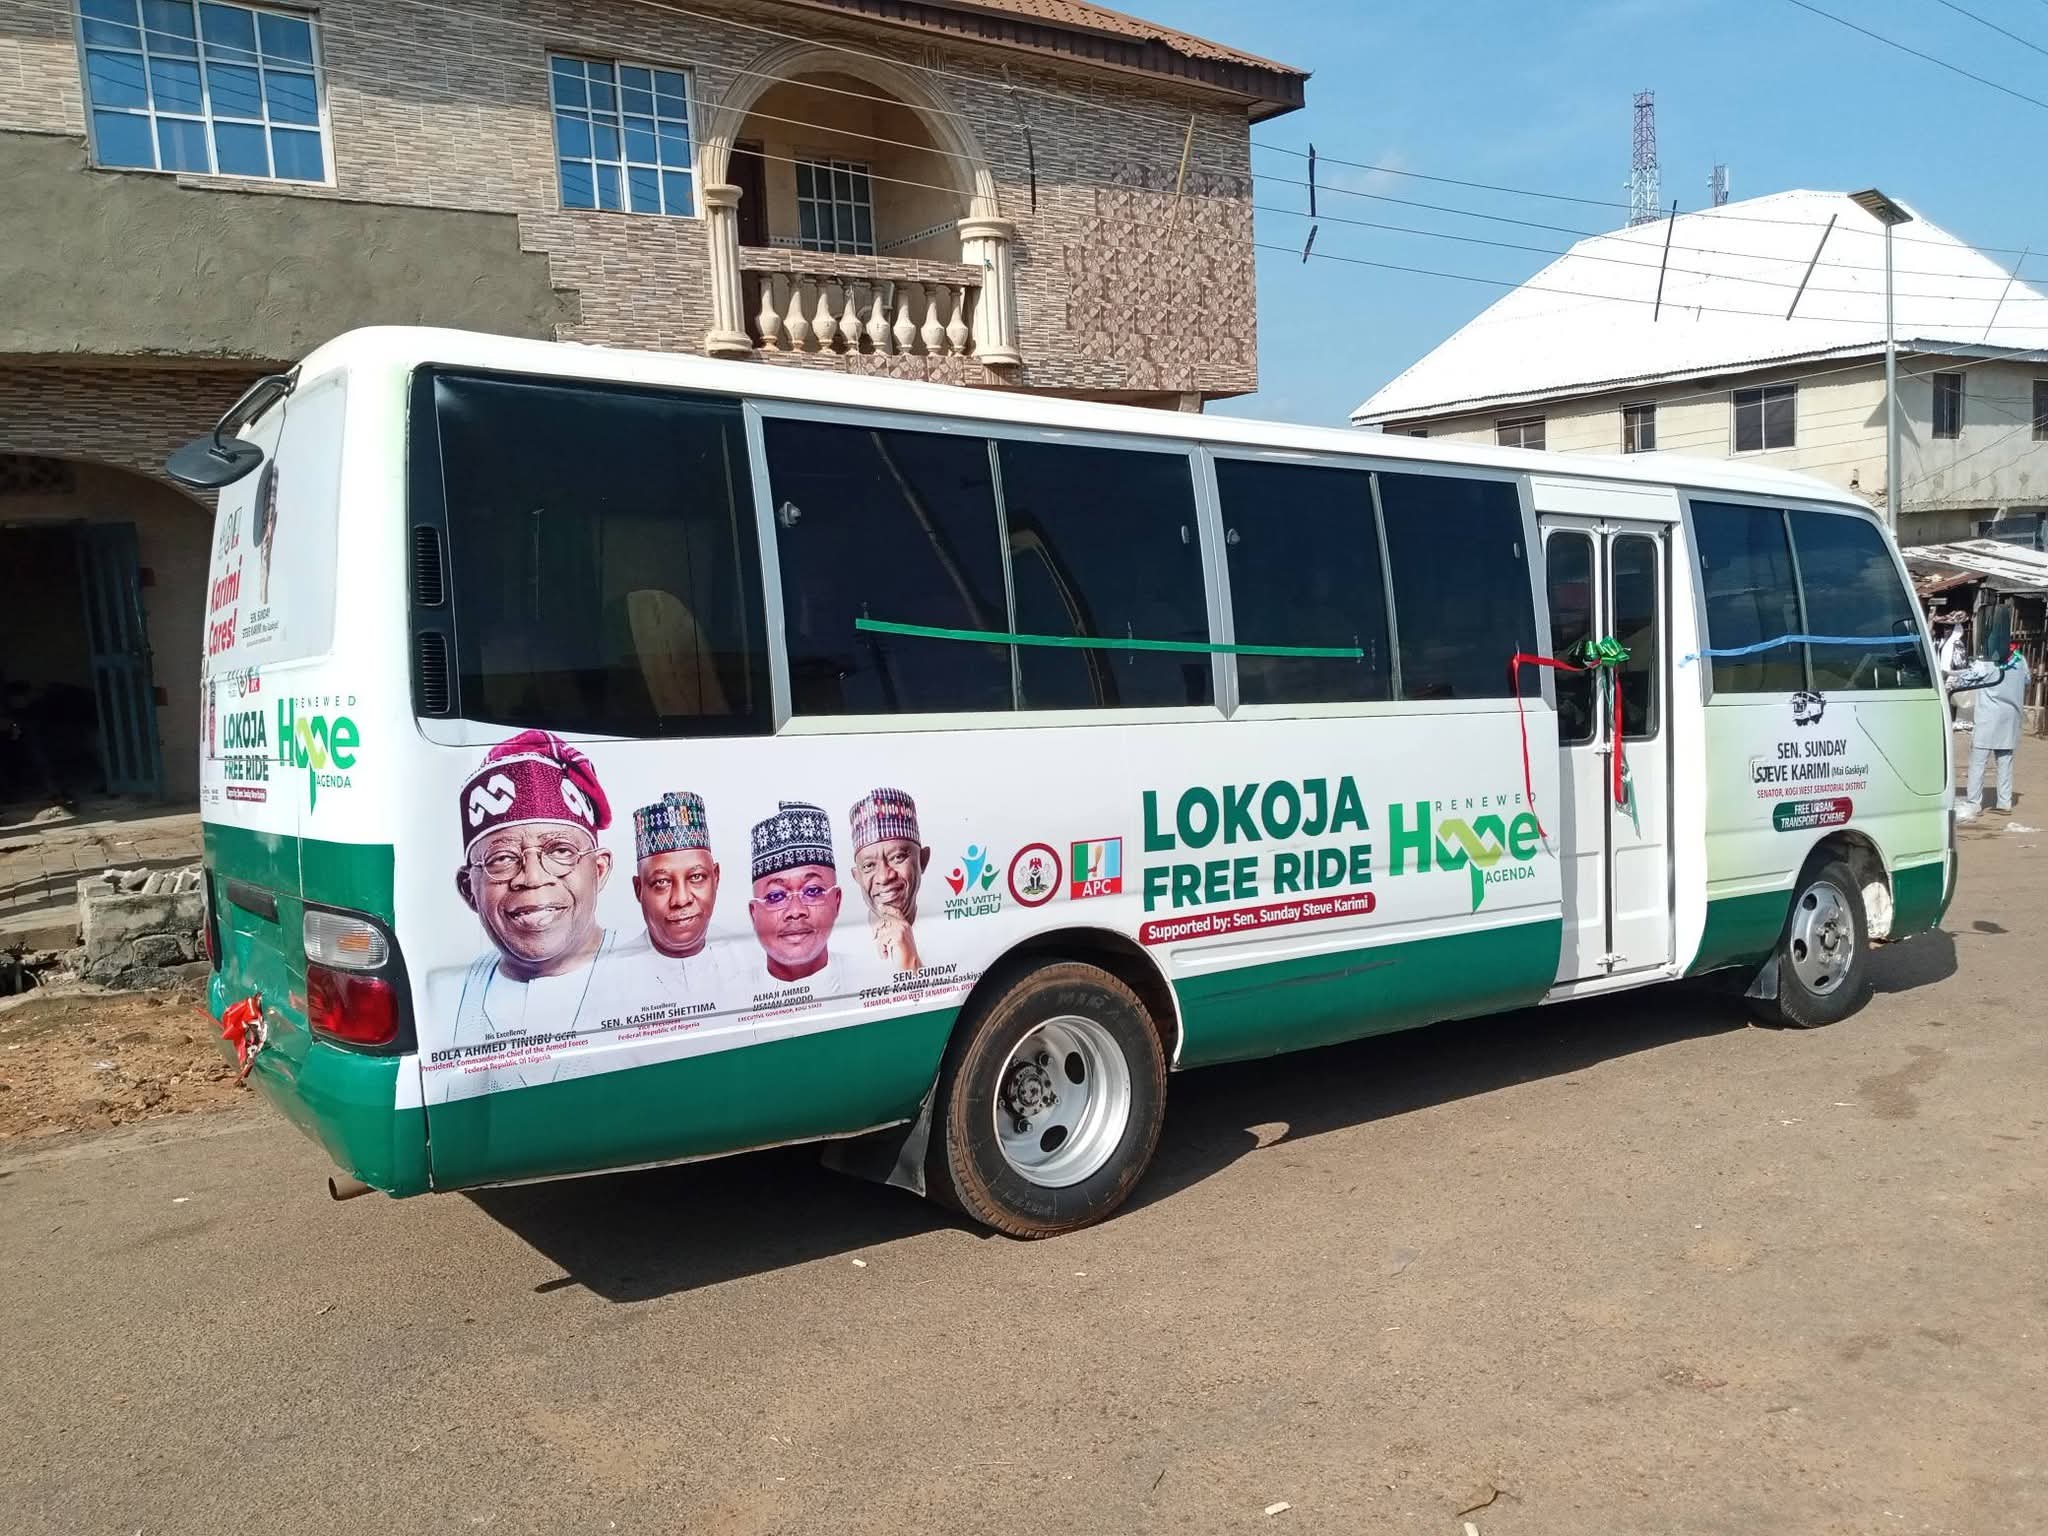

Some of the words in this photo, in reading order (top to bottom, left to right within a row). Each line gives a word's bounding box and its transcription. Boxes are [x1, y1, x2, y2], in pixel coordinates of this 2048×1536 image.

[211, 554, 242, 615] Karimi
[209, 608, 237, 657] Cares!
[296, 696, 356, 708] RENEWED
[224, 711, 267, 748] LOKOJA
[1778, 742, 1801, 759] SEN.
[1805, 740, 1846, 757] SUNDAY
[224, 755, 243, 780] FREE
[246, 755, 269, 781] RIDE
[1756, 765, 1787, 782] STEVE
[1792, 763, 1829, 780] KARIMI
[317, 776, 351, 788] AGENDA
[1436, 792, 1536, 811] RENEWED
[1795, 804, 1810, 814] FREE
[1143, 776, 1369, 852] LOKOJA
[1781, 815, 1817, 829] TRANSPORT
[1820, 812, 1845, 824] SCHEME
[1144, 856, 1258, 912] FREE
[1274, 844, 1372, 894] RIDE
[1485, 866, 1535, 884] AGENDA
[1083, 880, 1111, 896] APC
[946, 898, 968, 907] WIN
[971, 894, 1001, 904] WITH
[944, 903, 1000, 920] TINUBU
[1148, 917, 1210, 940] Supported
[1213, 915, 1231, 931] by:
[1233, 913, 1257, 926] Sen.
[1260, 907, 1300, 923] Sunday
[1303, 902, 1332, 916] Steve
[1334, 895, 1368, 912] Karimi
[893, 971, 915, 982] SEN.
[918, 964, 957, 978] SUNDAY
[753, 991, 779, 1002] ALHAJI
[782, 986, 810, 997] AHMED
[860, 985, 891, 999] STEVE
[601, 1018, 623, 1029] SEN.
[626, 1011, 665, 1024] KASHIM
[668, 1002, 716, 1017] SHETTIMA
[496, 1029, 527, 1039] Excellency
[421, 1062, 454, 1072] President,
[457, 1050, 524, 1066] Commander-in-Chief
[545, 1043, 567, 1051] Armed
[569, 1039, 588, 1047] Forces
[432, 1048, 461, 1062] BOLA
[465, 1041, 506, 1056] AHMED
[511, 1033, 551, 1049] TINUBU
